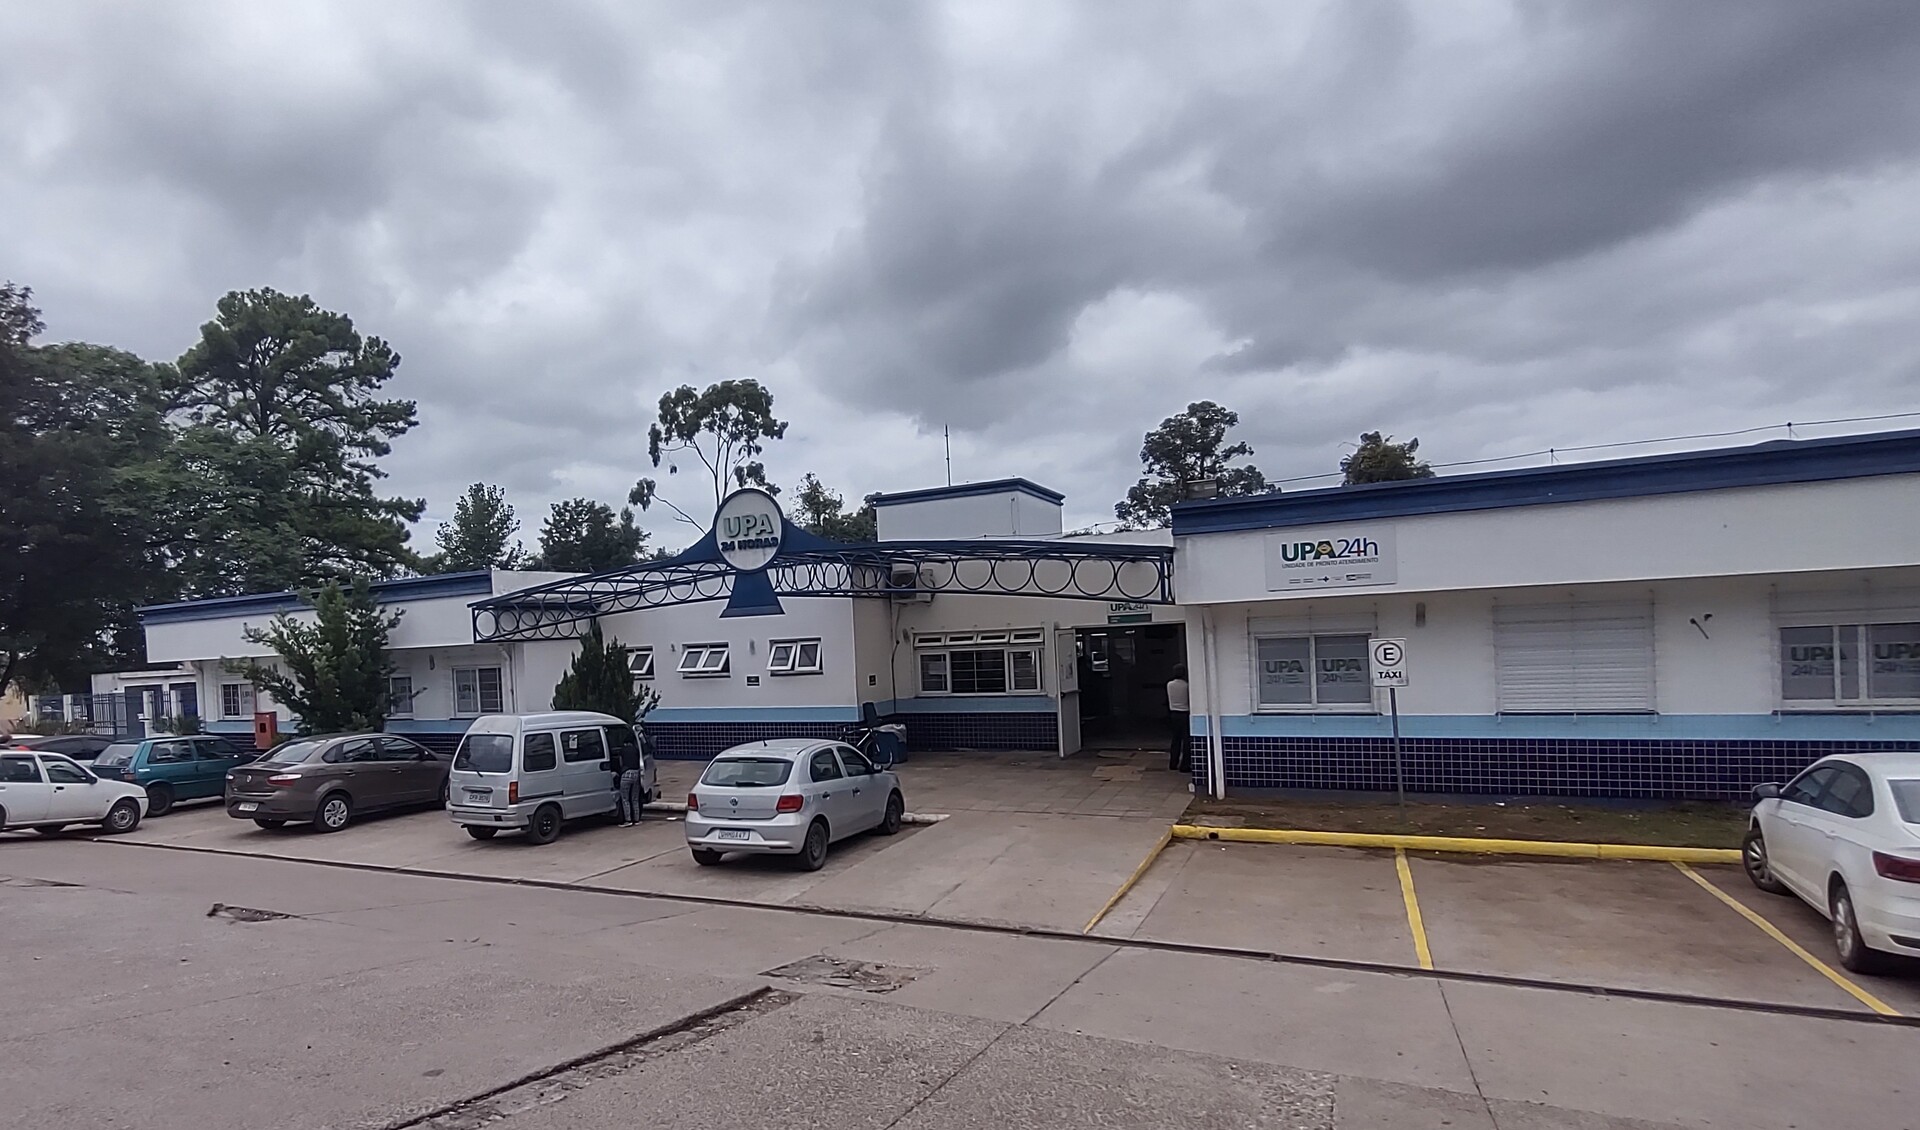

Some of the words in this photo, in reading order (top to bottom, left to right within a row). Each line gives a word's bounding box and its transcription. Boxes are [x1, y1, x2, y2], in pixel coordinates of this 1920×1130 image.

[723, 514, 773, 538] UPA
[721, 541, 735, 552] 24
[738, 537, 779, 550] HORAS
[1338, 557, 1379, 565] ATENDIMENTO
[1383, 647, 1395, 660] E
[1265, 660, 1304, 673] UPA
[1321, 658, 1362, 672] UPA
[1791, 664, 1818, 675] 24h
[1322, 673, 1342, 683] 24h
